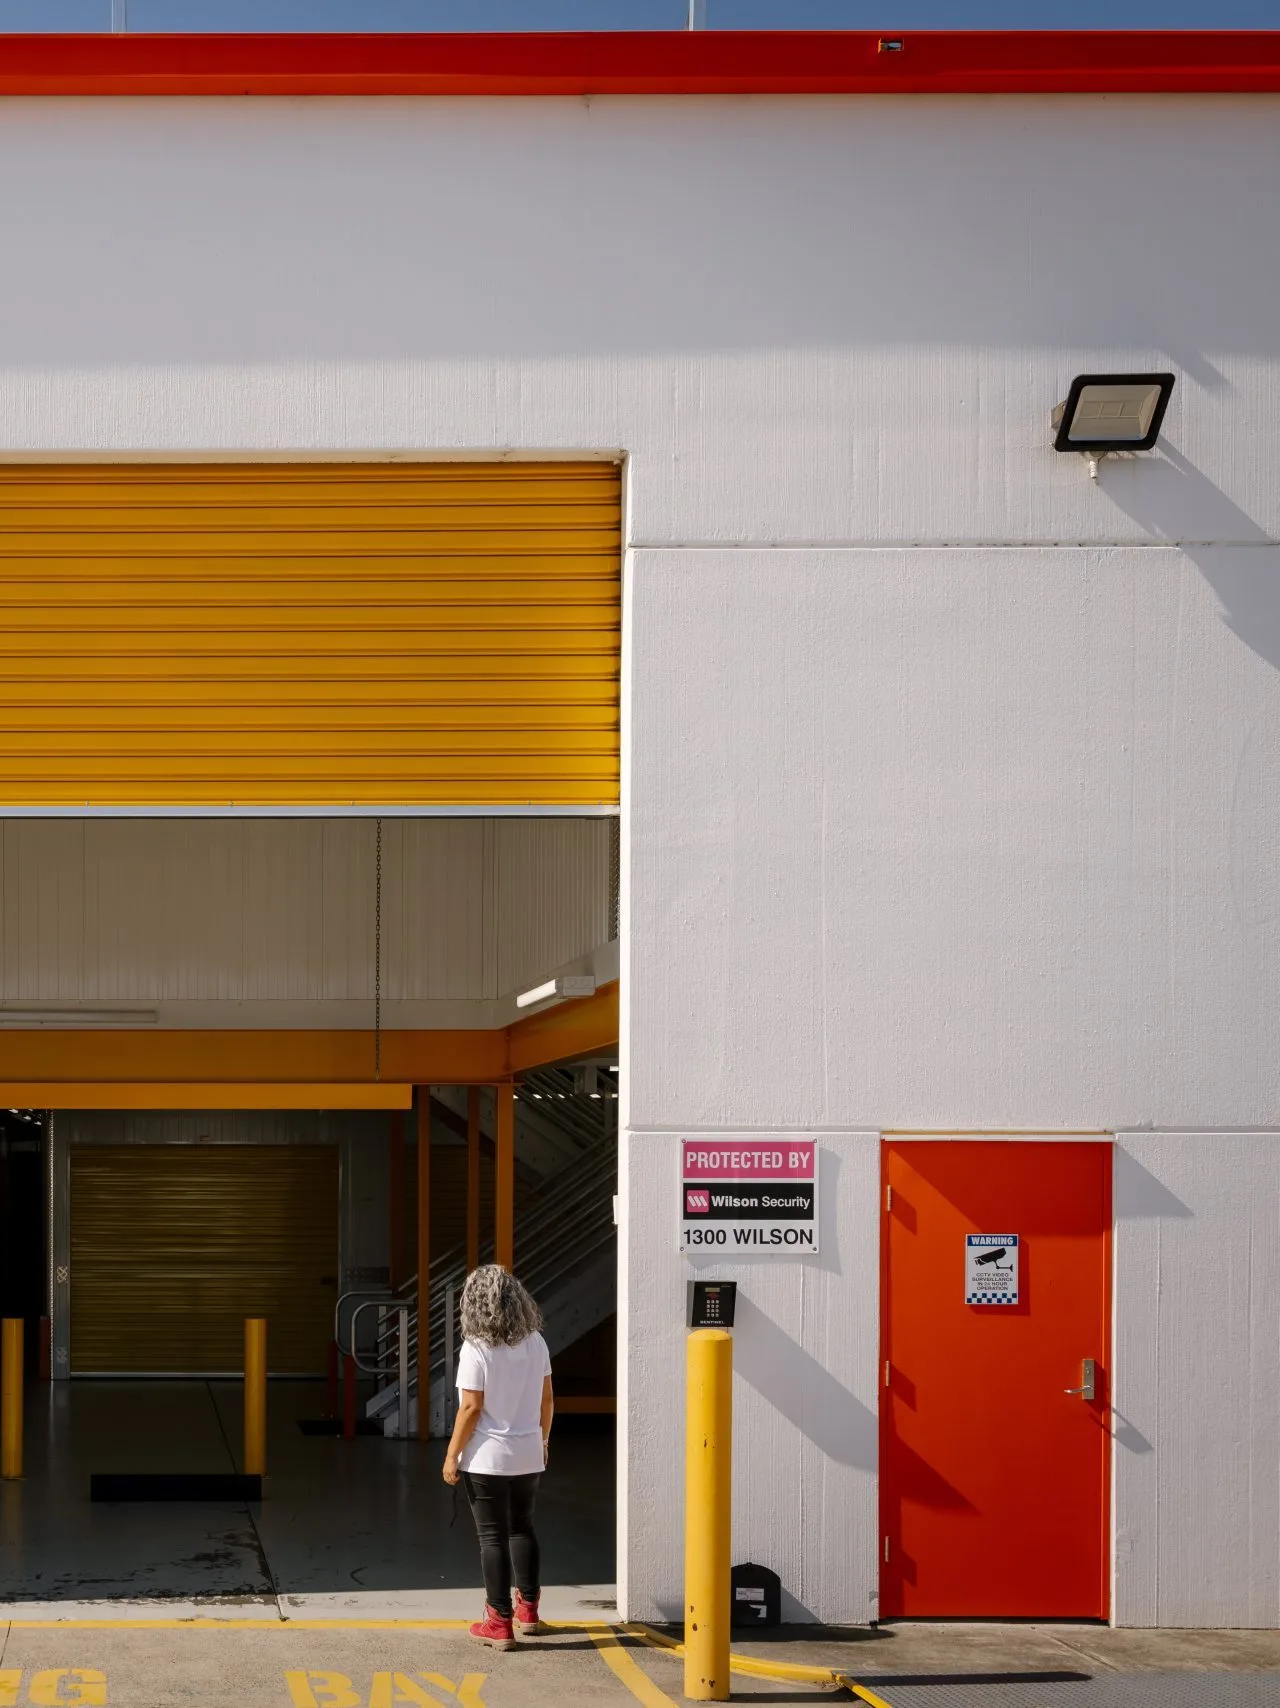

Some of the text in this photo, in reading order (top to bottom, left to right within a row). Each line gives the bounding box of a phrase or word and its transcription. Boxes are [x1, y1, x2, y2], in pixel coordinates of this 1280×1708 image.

[686, 1151, 811, 1169] PROTECTED BY
[711, 1195, 810, 1210] Wilson Security
[683, 1228, 813, 1245] 1300 WILSON
[971, 1236, 1013, 1245] WARNING
[284, 1670, 488, 1708] BAY
